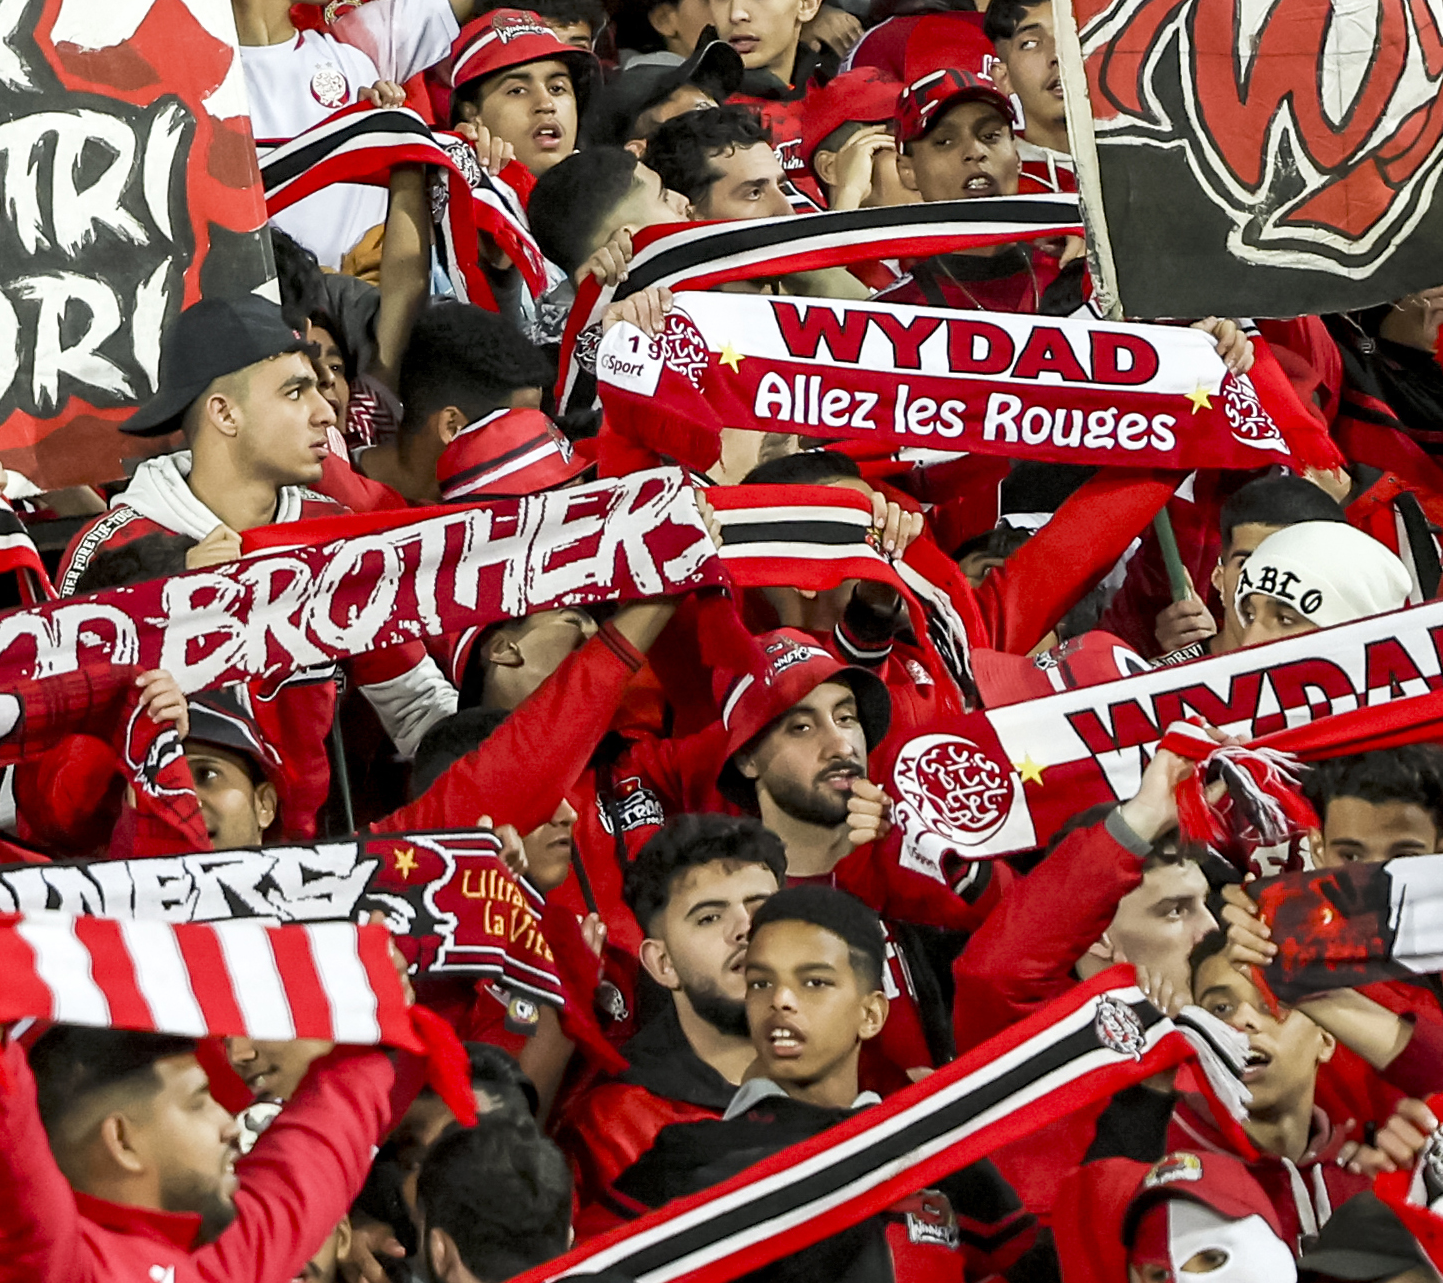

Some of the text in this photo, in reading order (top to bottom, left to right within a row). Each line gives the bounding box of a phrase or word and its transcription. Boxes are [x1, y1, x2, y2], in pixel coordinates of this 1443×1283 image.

[769, 295, 1163, 389] WYDAD
[753, 373, 1177, 454] Allez les Rouges
[143, 463, 716, 695] BROTHERS
[1066, 622, 1443, 807] WYDA
[483, 909, 506, 937] la
